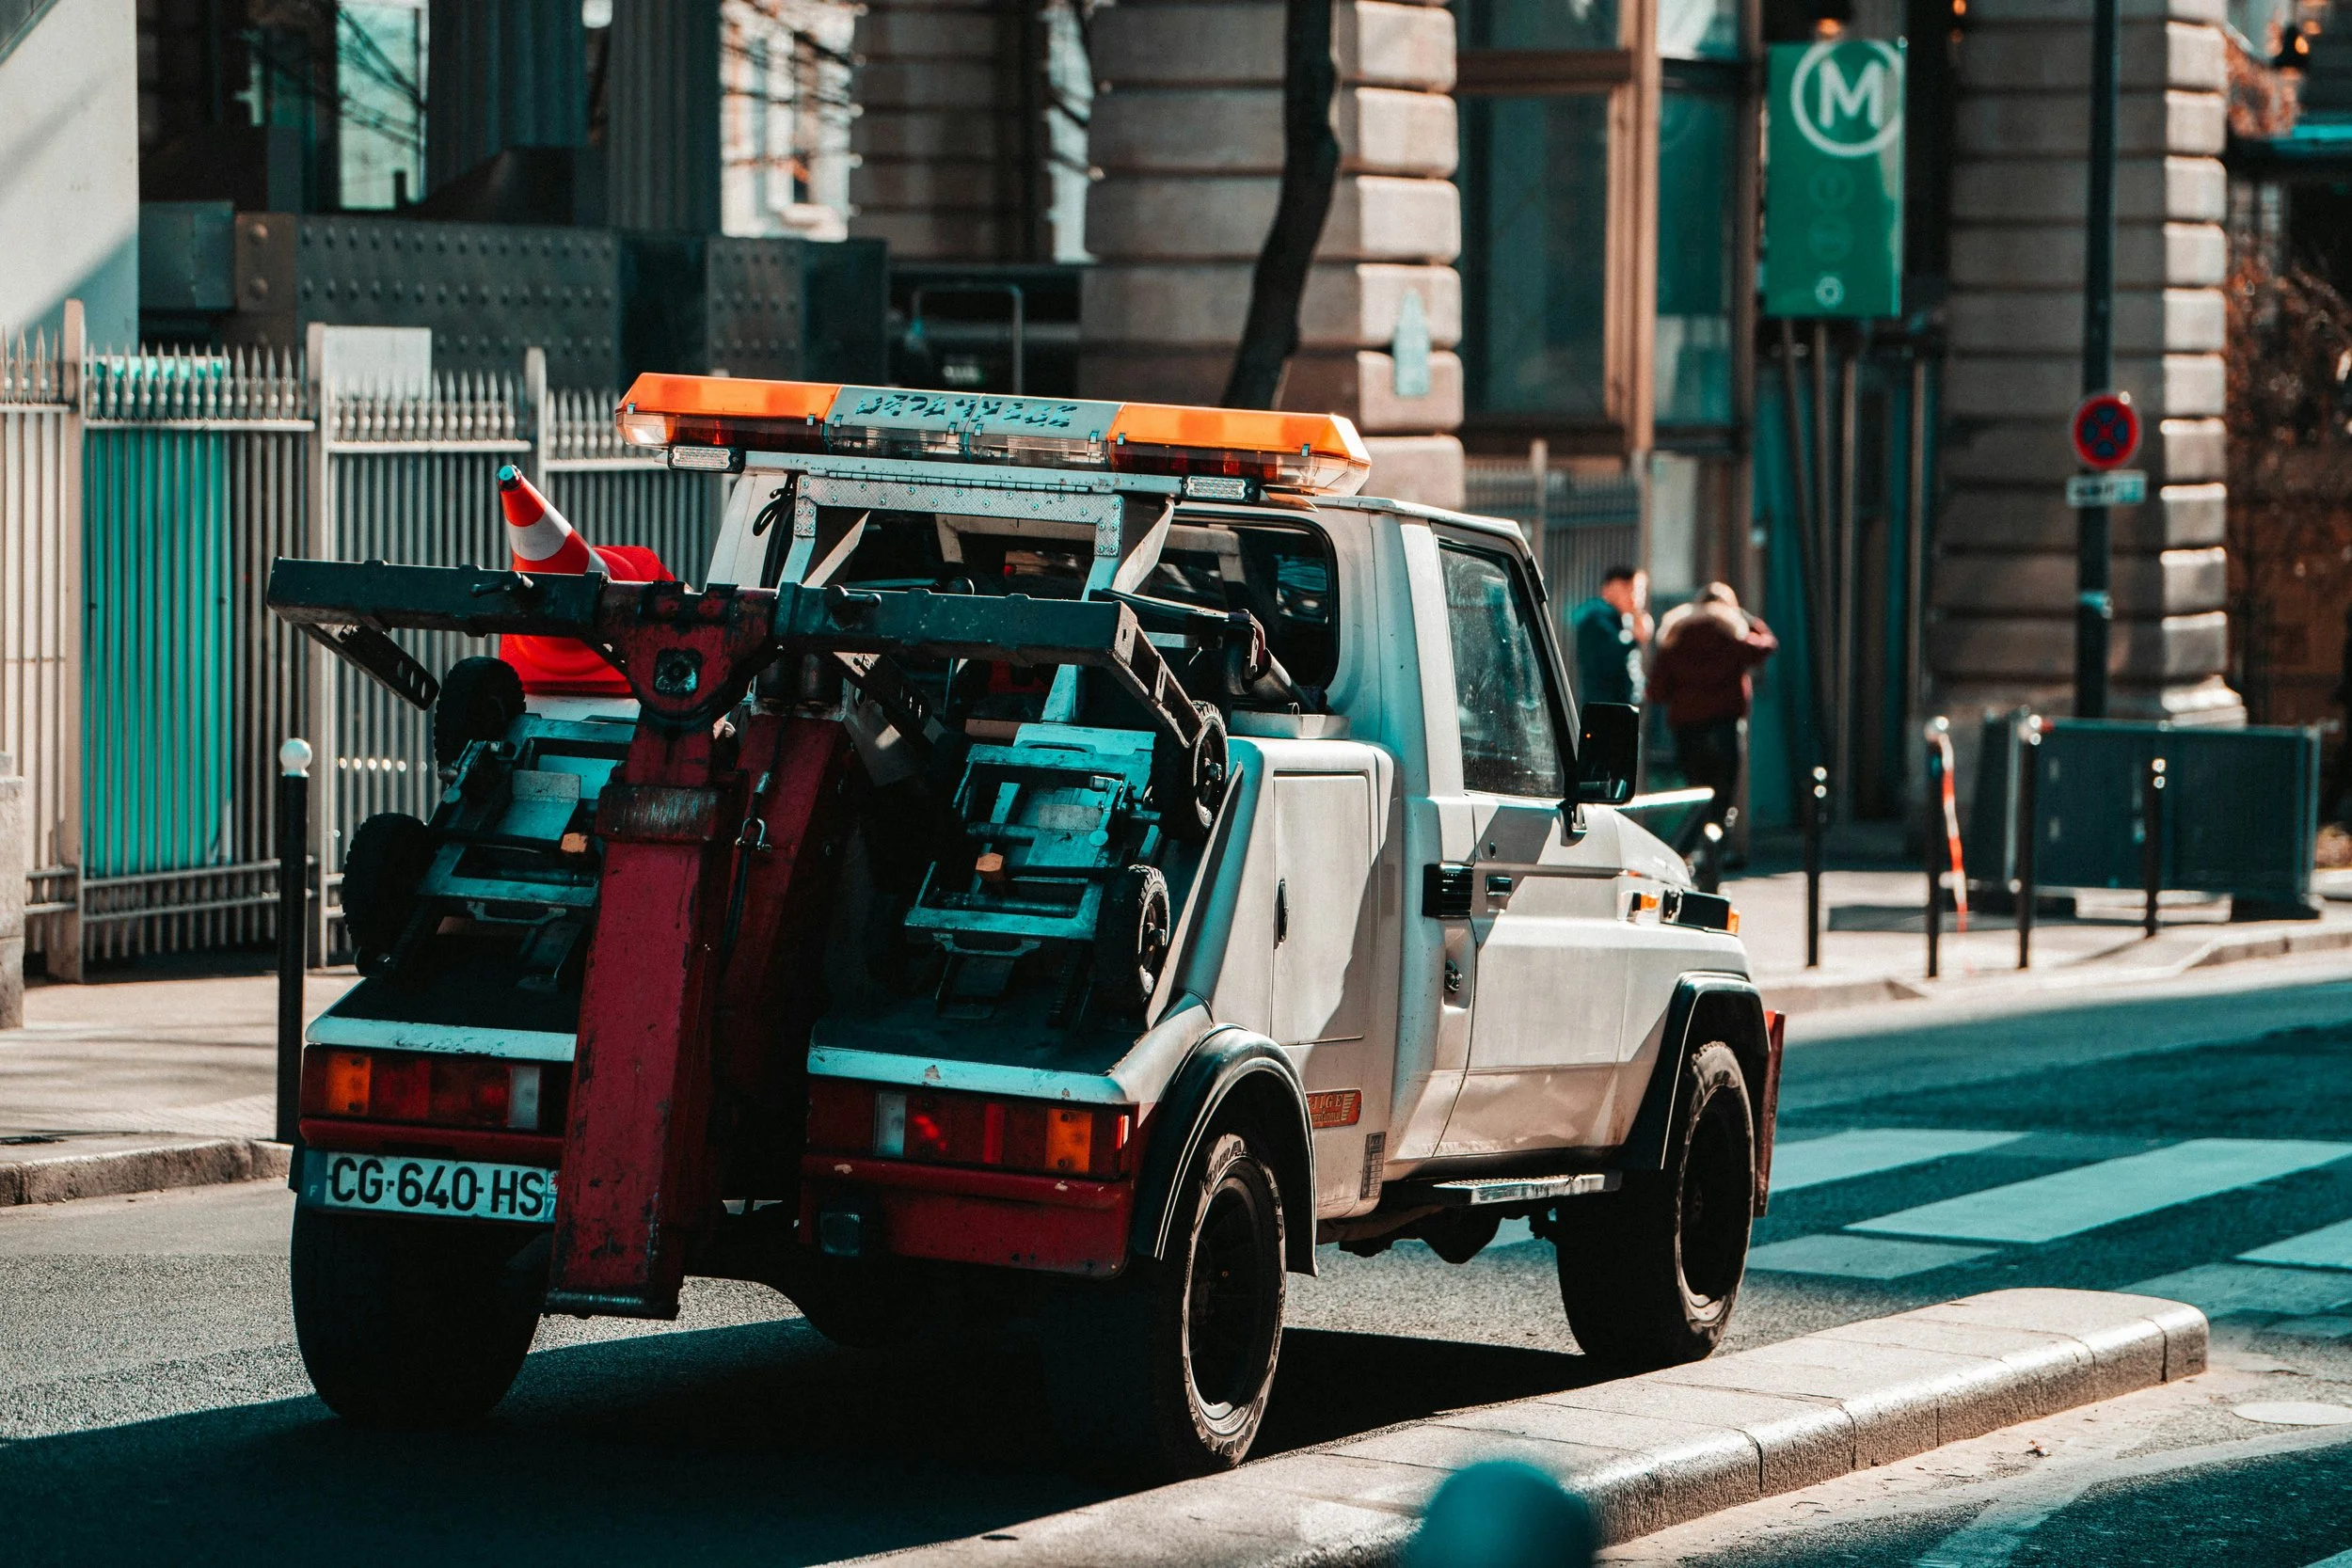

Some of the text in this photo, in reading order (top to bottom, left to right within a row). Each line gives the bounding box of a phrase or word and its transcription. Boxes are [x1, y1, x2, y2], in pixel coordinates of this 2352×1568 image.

[1819, 57, 1883, 129] M
[310, 1185, 318, 1197] F
[331, 1157, 544, 1216] CG-640-HS
